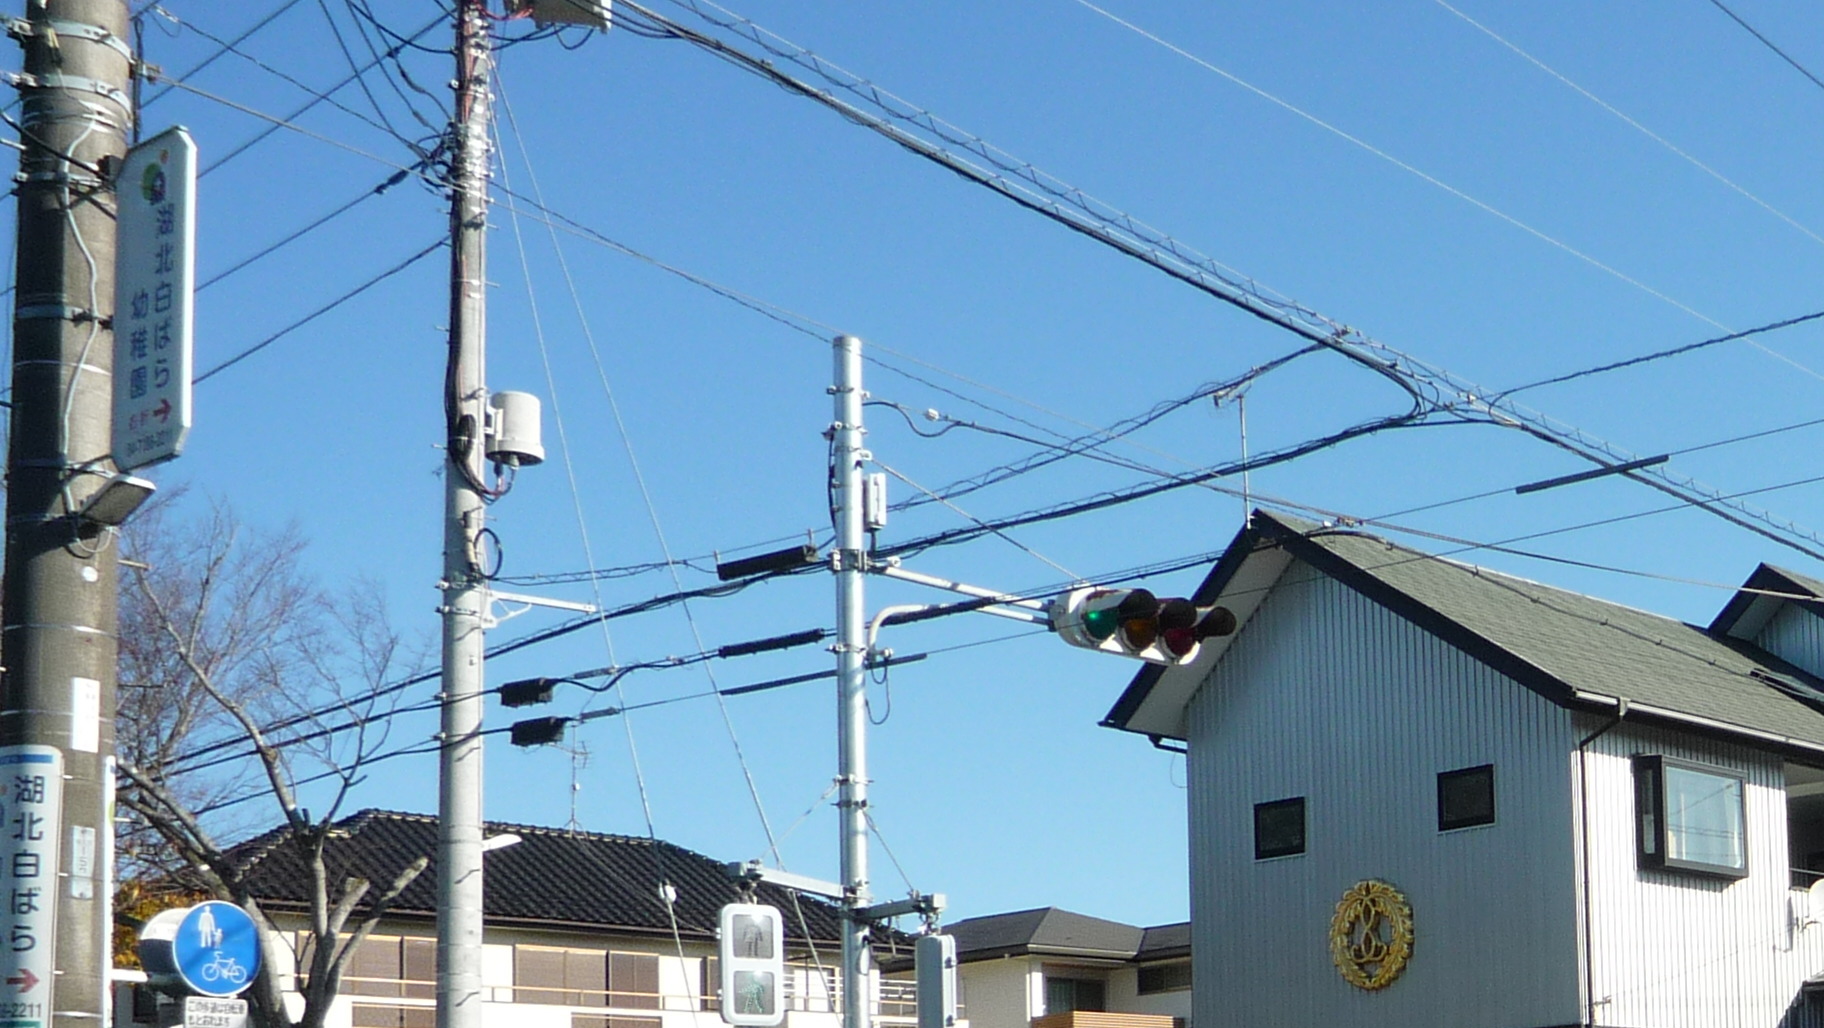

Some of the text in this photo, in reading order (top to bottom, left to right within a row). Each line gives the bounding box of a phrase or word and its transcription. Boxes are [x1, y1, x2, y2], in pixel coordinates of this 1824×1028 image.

[11, 774, 45, 952] 湖北白ばら
